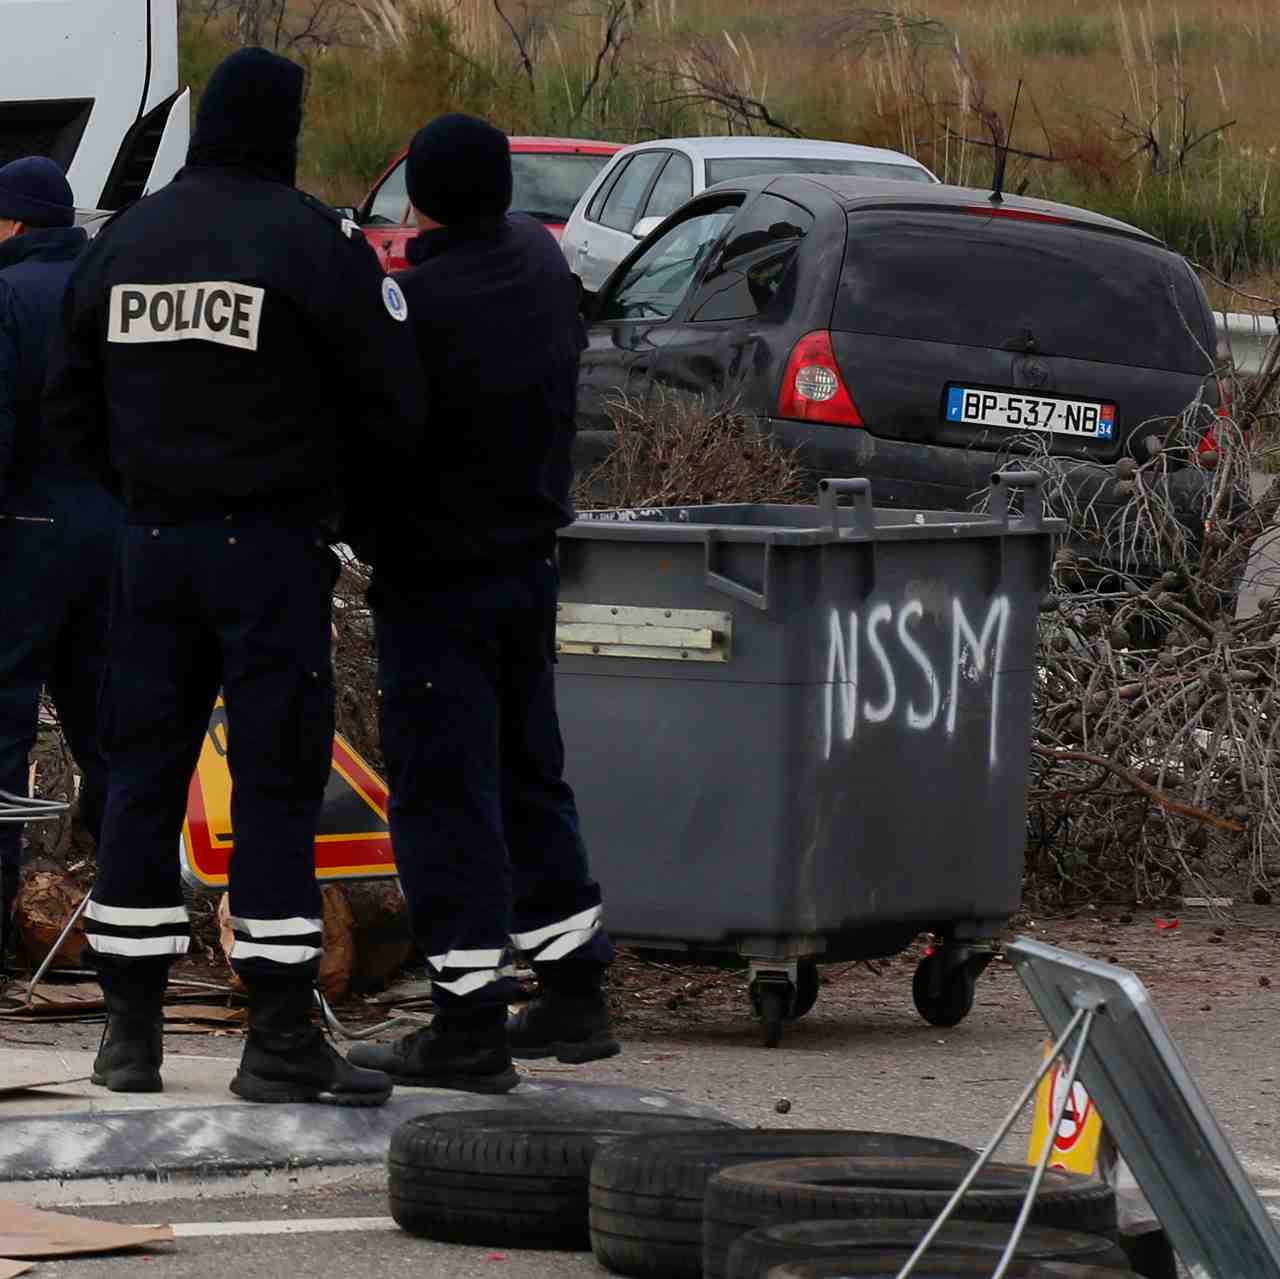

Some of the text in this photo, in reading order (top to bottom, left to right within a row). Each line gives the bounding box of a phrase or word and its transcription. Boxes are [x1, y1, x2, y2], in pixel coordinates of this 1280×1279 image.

[119, 287, 254, 339] POLICE
[963, 393, 1099, 434] BP-537-NB
[1098, 423, 1112, 436] 34
[820, 593, 1011, 771] NSSM
